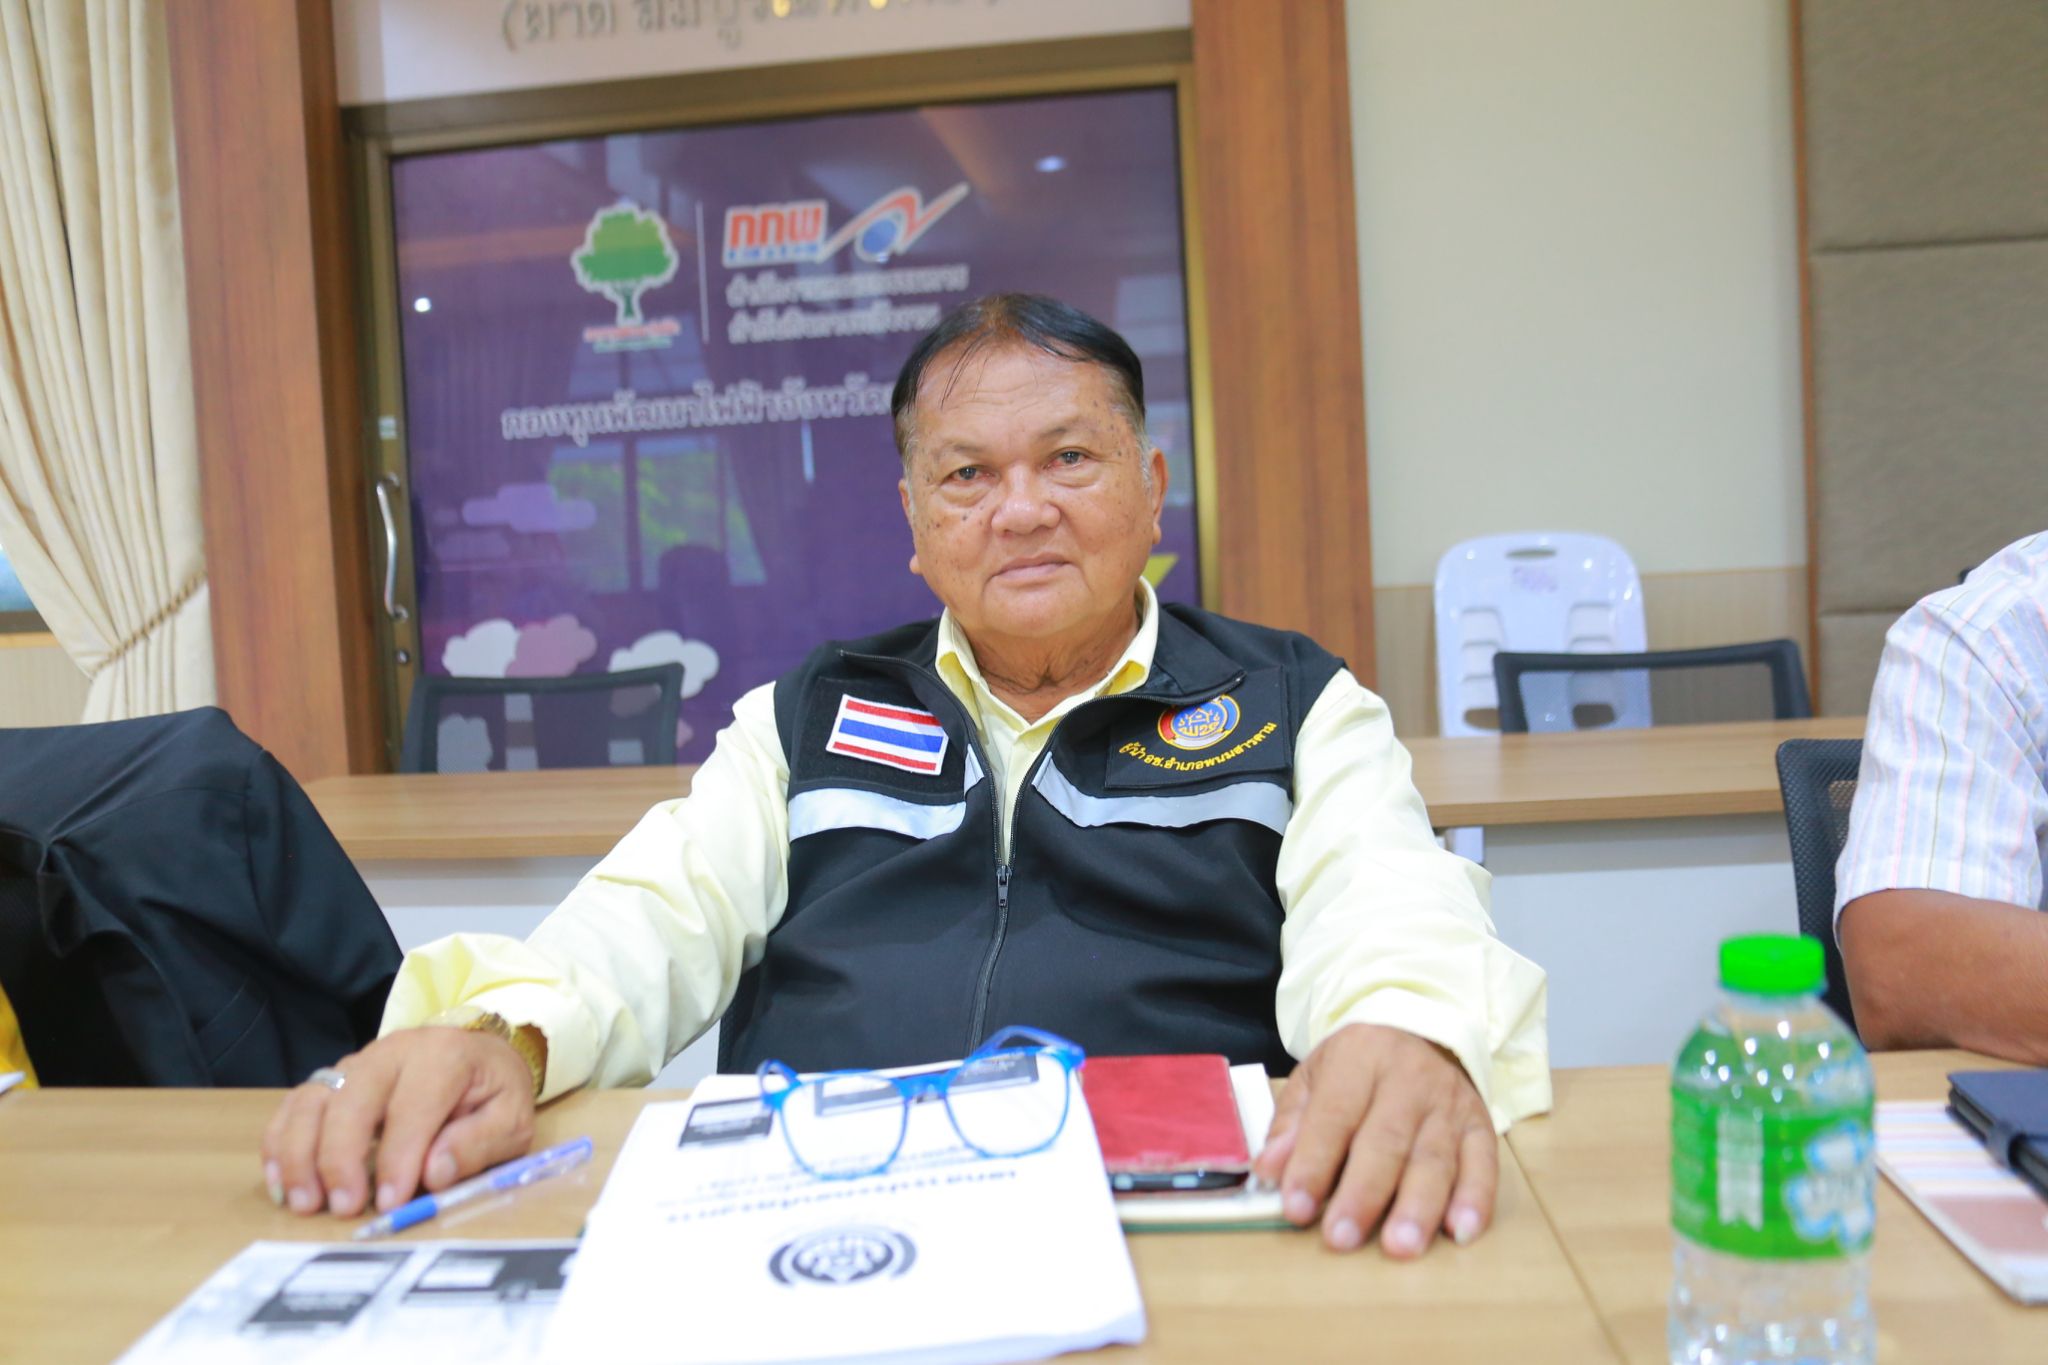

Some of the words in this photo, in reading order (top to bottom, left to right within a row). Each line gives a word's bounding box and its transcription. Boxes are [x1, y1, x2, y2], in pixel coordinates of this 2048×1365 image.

[729, 205, 822, 250] กกพ
[501, 372, 892, 447] กองทุนพัฒนาไฟฟ้าจังหวัด
